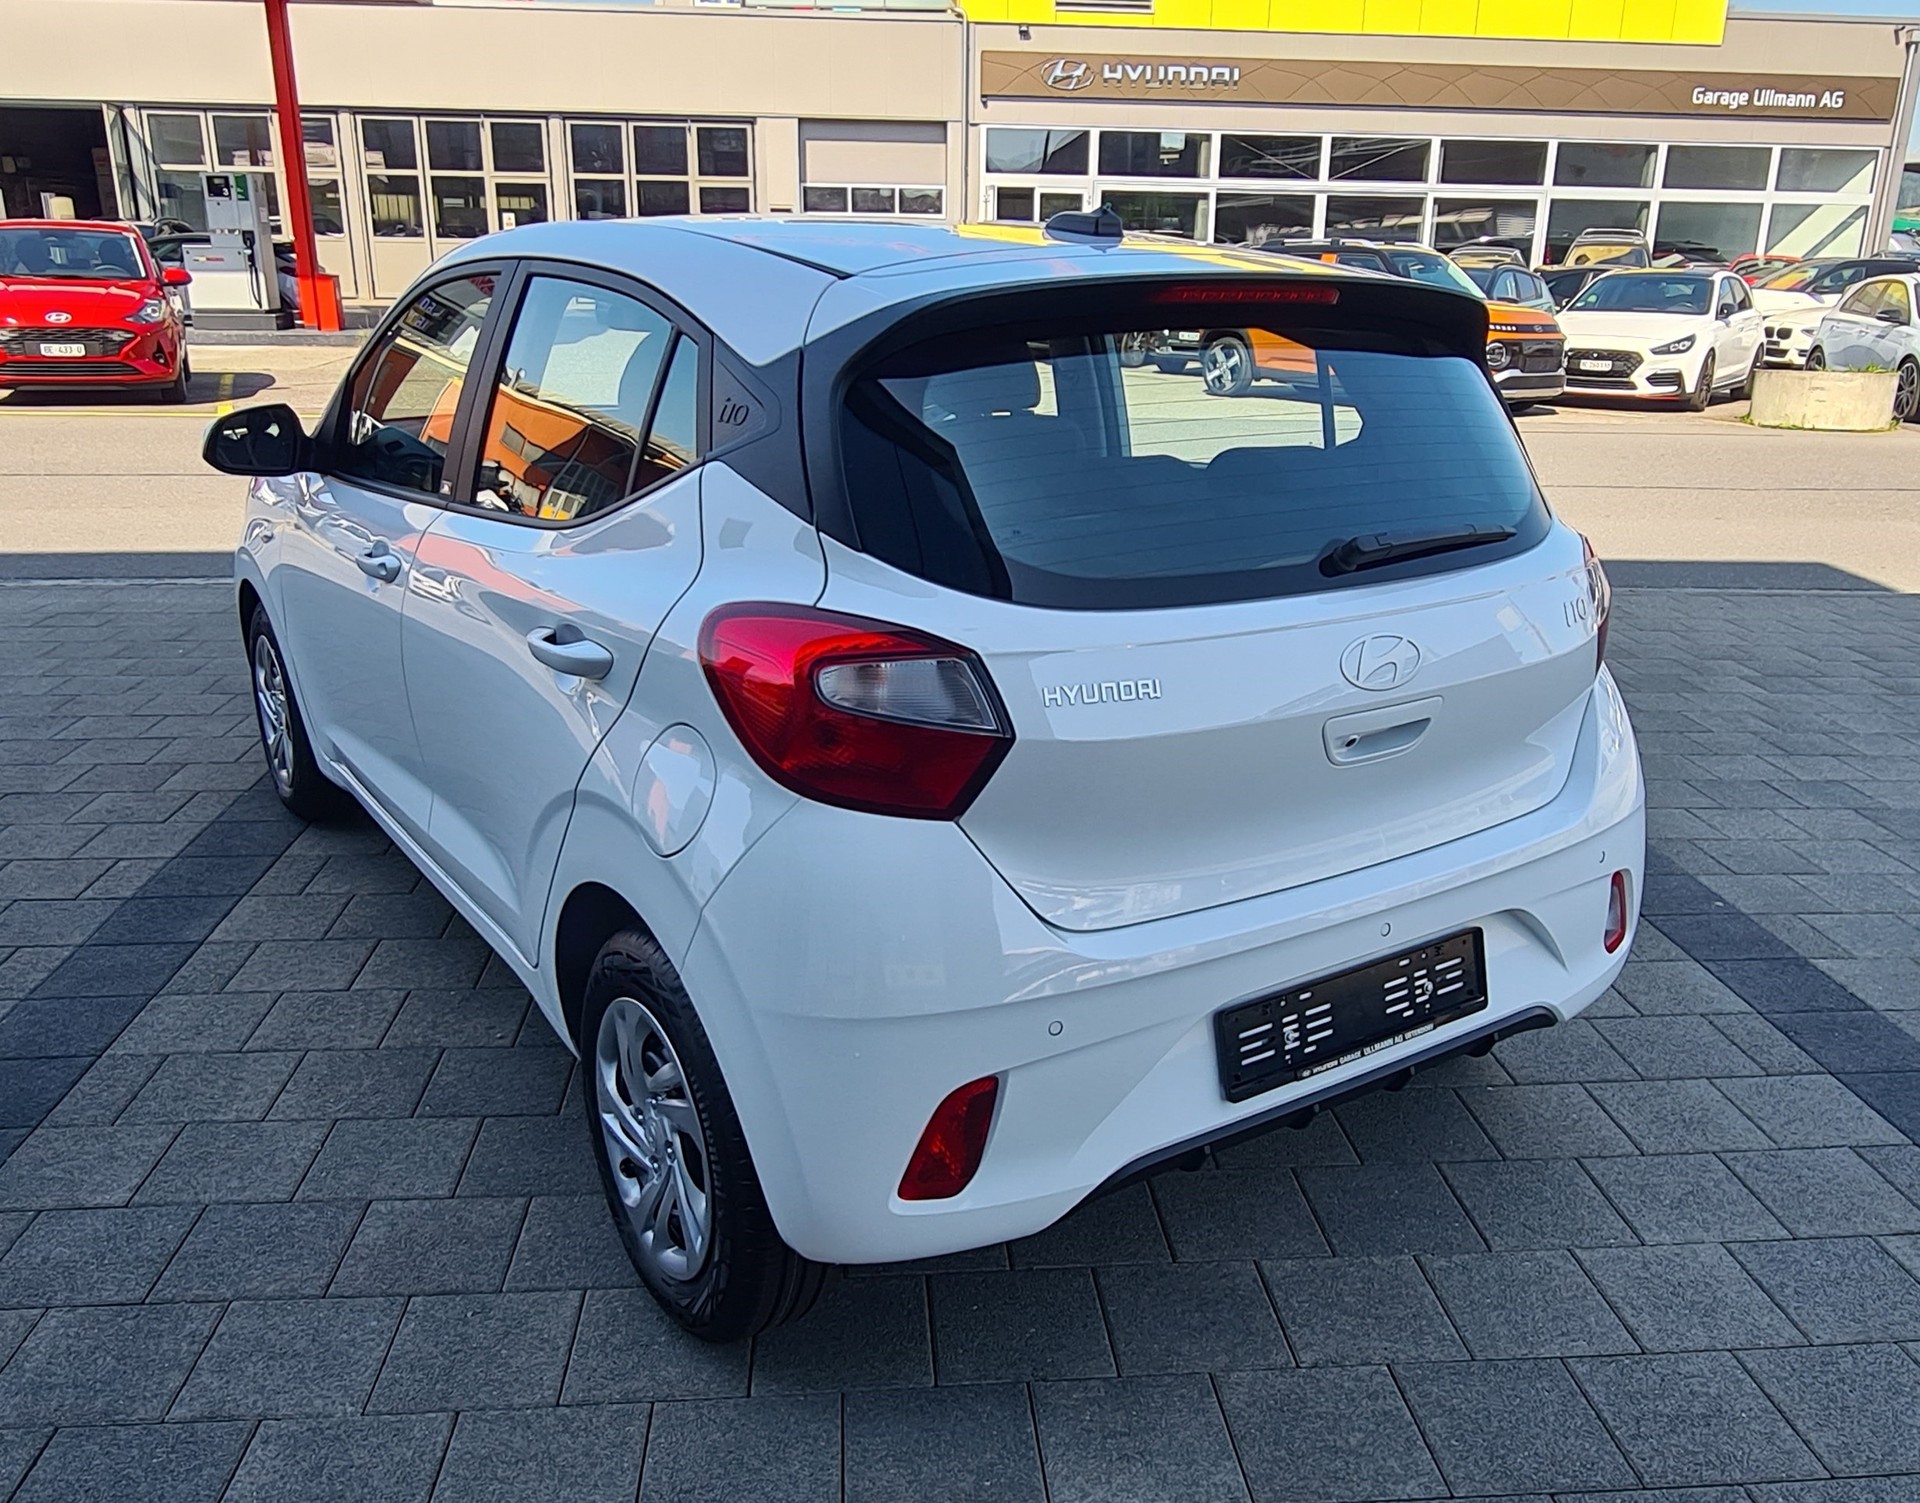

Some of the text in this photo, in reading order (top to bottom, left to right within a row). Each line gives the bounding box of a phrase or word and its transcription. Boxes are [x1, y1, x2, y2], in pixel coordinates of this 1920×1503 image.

[1102, 63, 1241, 91] HYUNDAI
[1692, 87, 1845, 109] Garage Ullmann AG
[718, 397, 749, 426] i10
[1042, 678, 1161, 708] HYUNDAI
[1339, 1050, 1362, 1065] GARAGE
[1363, 1036, 1394, 1056] ULLMANN
[1394, 1033, 1404, 1045] AG
